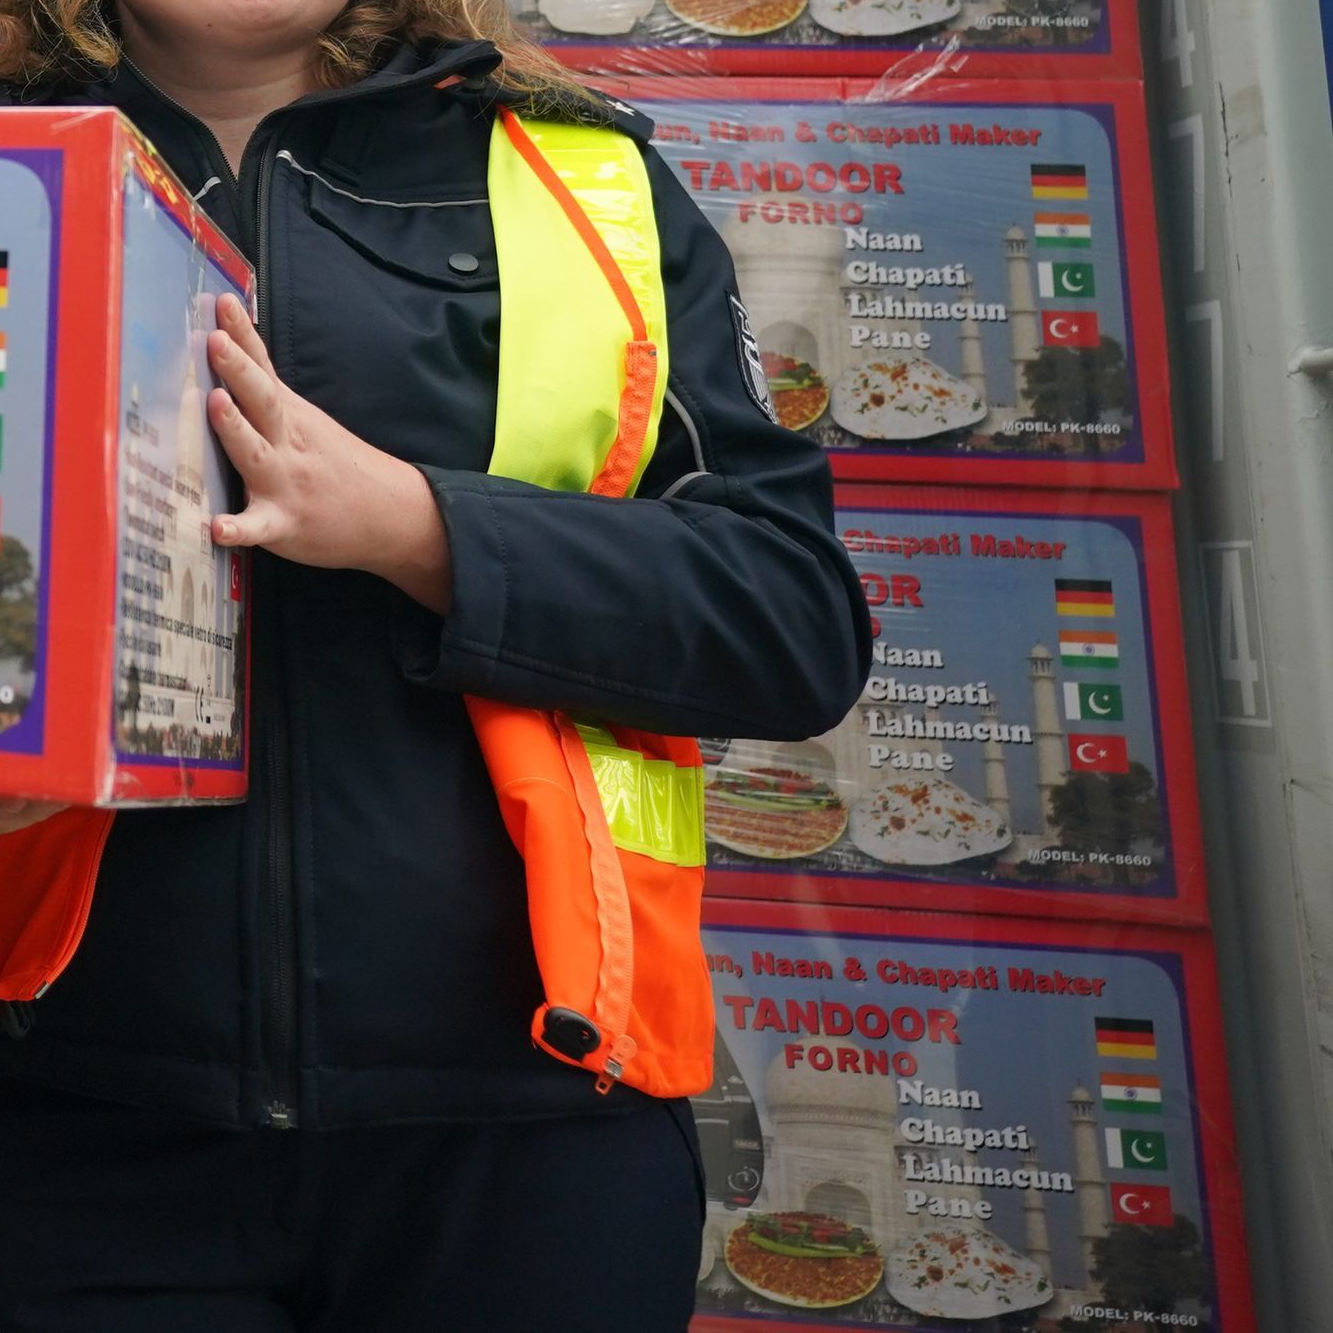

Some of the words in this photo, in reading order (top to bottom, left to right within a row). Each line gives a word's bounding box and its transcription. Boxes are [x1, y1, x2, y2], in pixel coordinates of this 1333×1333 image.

[709, 119, 785, 144] Naan
[795, 121, 817, 144] &
[825, 122, 942, 149] Chapati
[948, 124, 1043, 148] Maker
[680, 160, 906, 196] TANDOOR
[738, 201, 866, 226] FORNO
[843, 226, 923, 254] Naan
[844, 260, 970, 290] Chapati
[848, 291, 1009, 323] Lahmacun
[848, 324, 933, 352] Pane
[1002, 419, 1058, 435] MODEL:
[1059, 420, 1121, 436] PK-8660
[843, 528, 960, 559] Chapati
[969, 533, 1067, 561] Maker
[871, 641, 945, 669] Naan
[864, 675, 991, 708] Chapati
[866, 709, 1034, 744] Lahmacun
[867, 743, 955, 773] Pane
[1028, 848, 1086, 865] MODEL:
[1088, 850, 1152, 867] PK-8660
[751, 951, 833, 982] Naan
[842, 956, 868, 983] &
[875, 958, 999, 993] Chapati
[1007, 968, 1107, 999] Maker
[723, 994, 963, 1045] TANDOOR
[783, 1042, 920, 1078] FORNO
[897, 1079, 983, 1112] Naan
[900, 1118, 1030, 1155] Chapati
[903, 1153, 1076, 1194] Lahmacun
[904, 1189, 993, 1222] Pane
[1070, 1303, 1131, 1325] MODEL:
[1132, 1307, 1199, 1328] PK-8660
